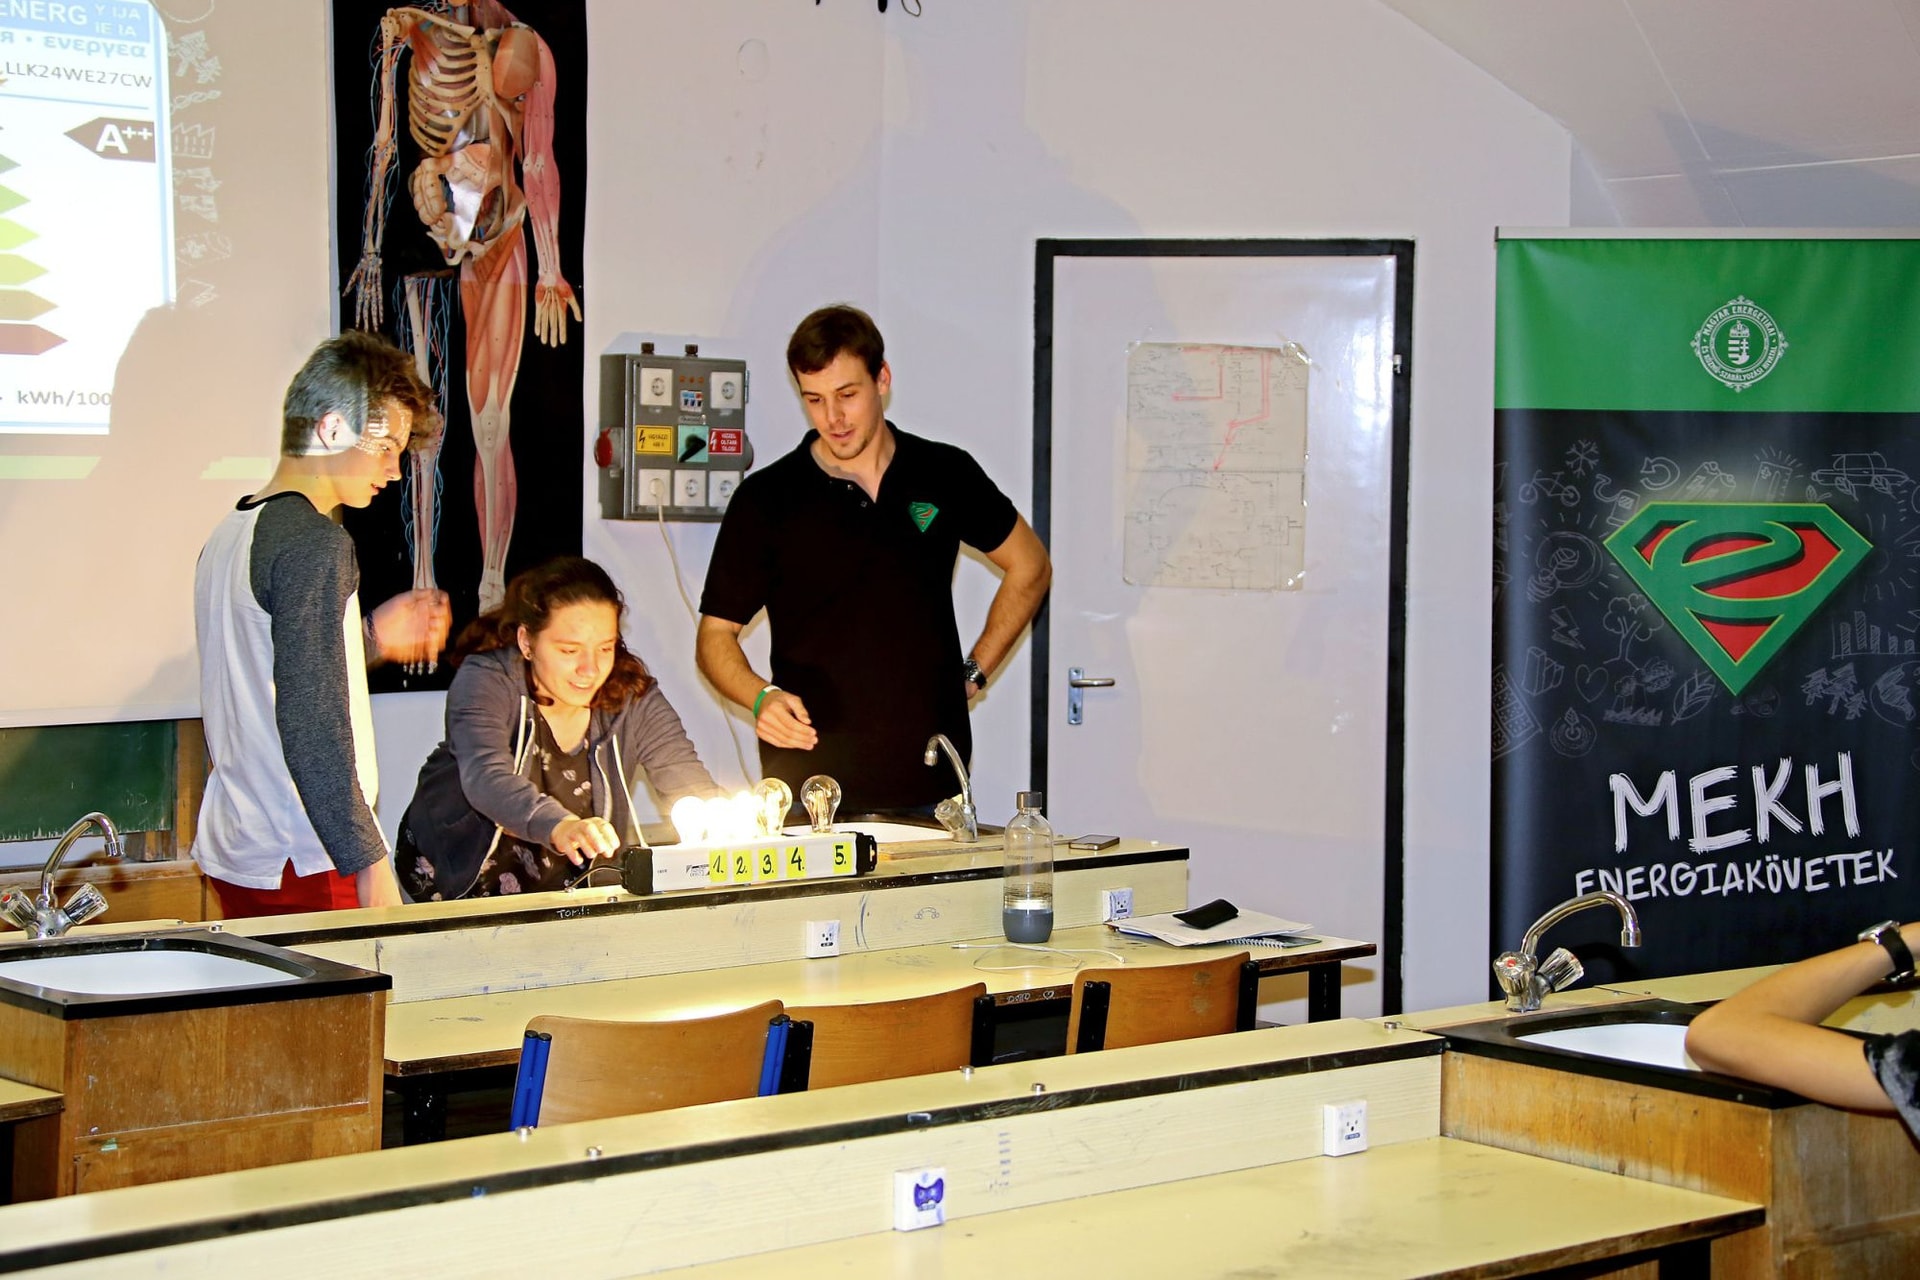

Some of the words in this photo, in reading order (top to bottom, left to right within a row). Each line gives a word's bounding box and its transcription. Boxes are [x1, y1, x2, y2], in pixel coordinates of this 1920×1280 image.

[94, 4, 106, 16] Y
[112, 6, 141, 20] IJA
[95, 21, 113, 34] IE
[118, 23, 137, 37] IA
[95, 123, 153, 155] A++
[1703, 308, 1730, 336] MAGYAR
[1732, 305, 1777, 336] ENERGETIKAI
[1609, 750, 1860, 854] MEKH
[762, 854, 775, 875] 3.
[790, 846, 805, 872] 4.
[834, 844, 847, 866] 5.
[1575, 848, 1898, 901] ENERGIAKÖVETEK
